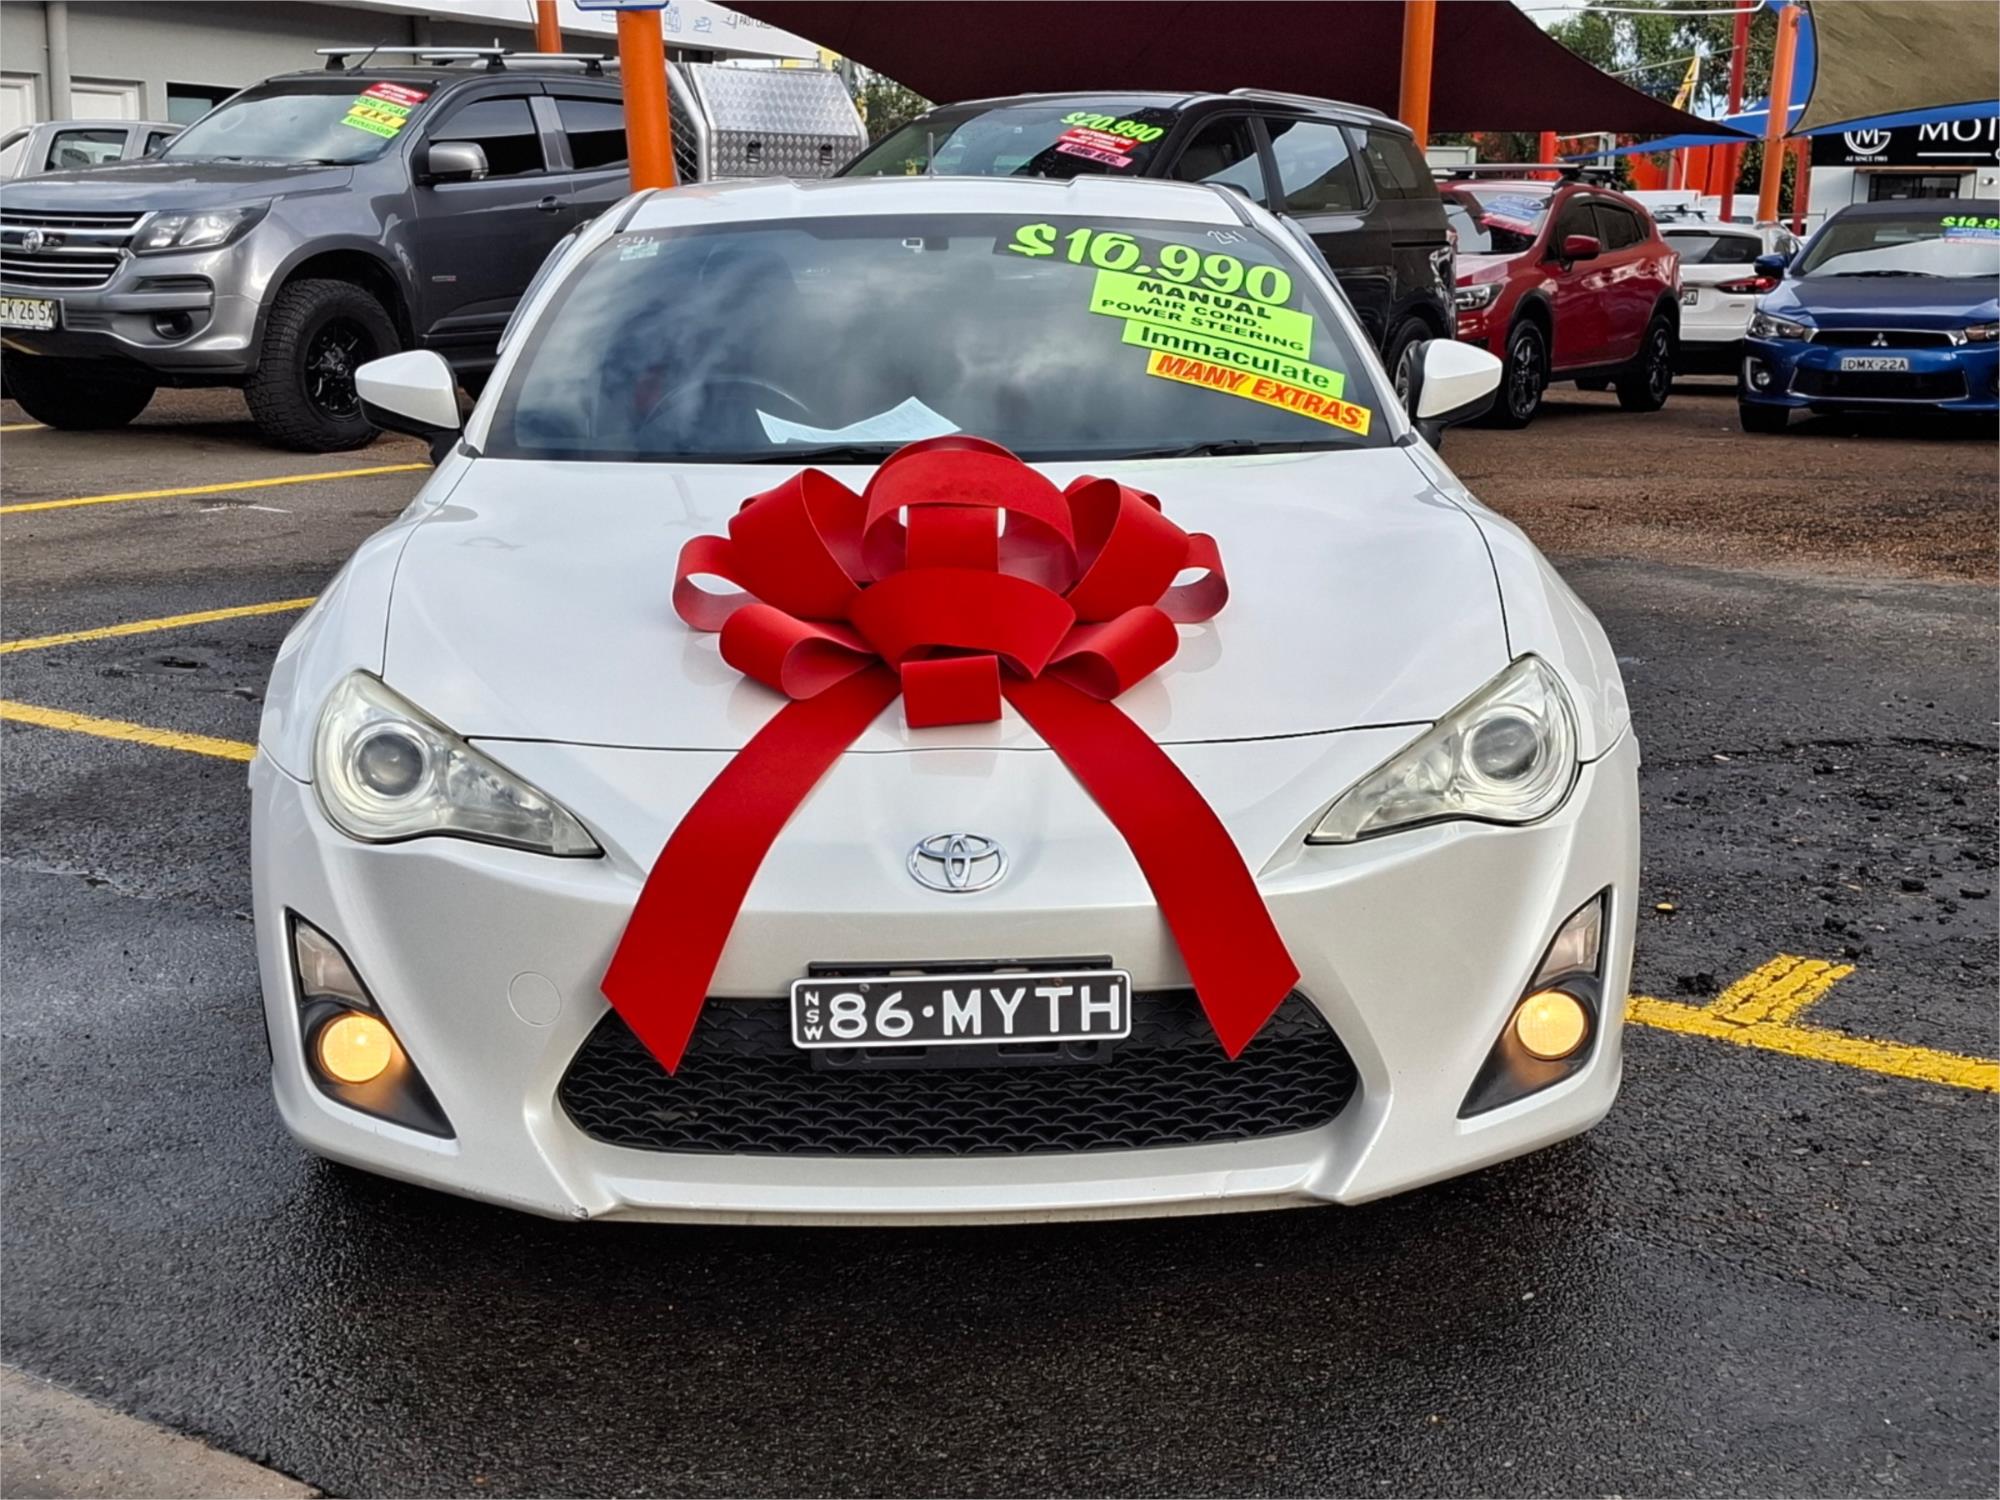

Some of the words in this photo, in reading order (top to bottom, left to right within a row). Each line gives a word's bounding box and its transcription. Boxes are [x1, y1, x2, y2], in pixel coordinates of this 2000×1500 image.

[1060, 111, 1164, 142] $20.990
[1207, 230, 1248, 245] 241
[1940, 216, 2000, 229] $14.9
[1008, 223, 1292, 306] $16.990
[20, 301, 35, 320] 26
[39, 302, 55, 322] SX
[1137, 280, 1272, 320] MANUAL
[1148, 297, 1186, 312] AIR
[1193, 306, 1263, 330] COND.
[1101, 299, 1183, 323] POWER
[1190, 316, 1305, 352] STEERING
[1140, 326, 1330, 389] Immaculate
[1156, 354, 1245, 392] MANY
[1251, 378, 1364, 428] EXTRAS
